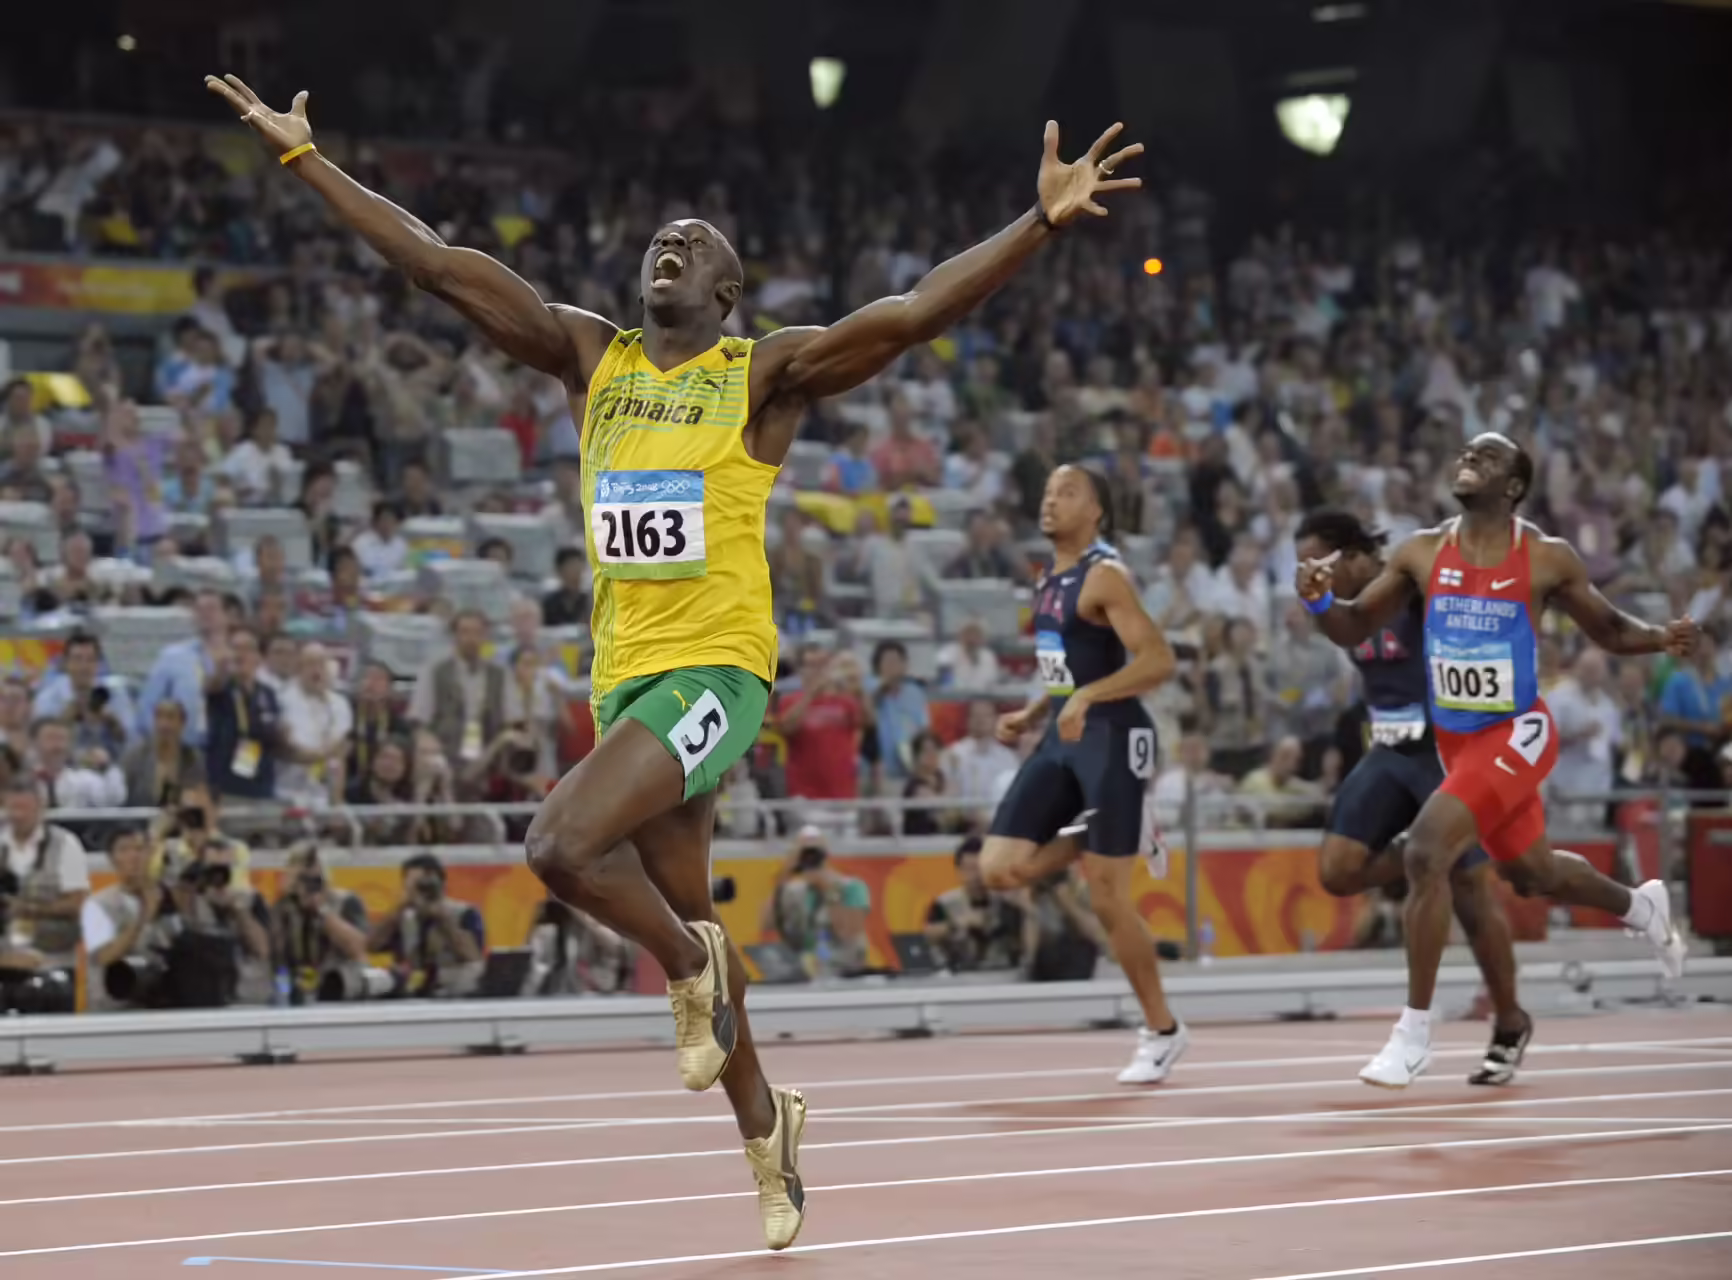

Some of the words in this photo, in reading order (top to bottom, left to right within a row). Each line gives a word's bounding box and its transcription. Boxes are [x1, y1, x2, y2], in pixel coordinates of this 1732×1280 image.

[601, 509, 687, 558] 2163
[1434, 596, 1517, 619] NETHERLANDS
[1446, 613, 1500, 631] ANTILLES
[1437, 662, 1500, 698] 1003
[681, 707, 722, 755] 5
[1520, 718, 1543, 748] 7
[1136, 736, 1149, 771] 9
